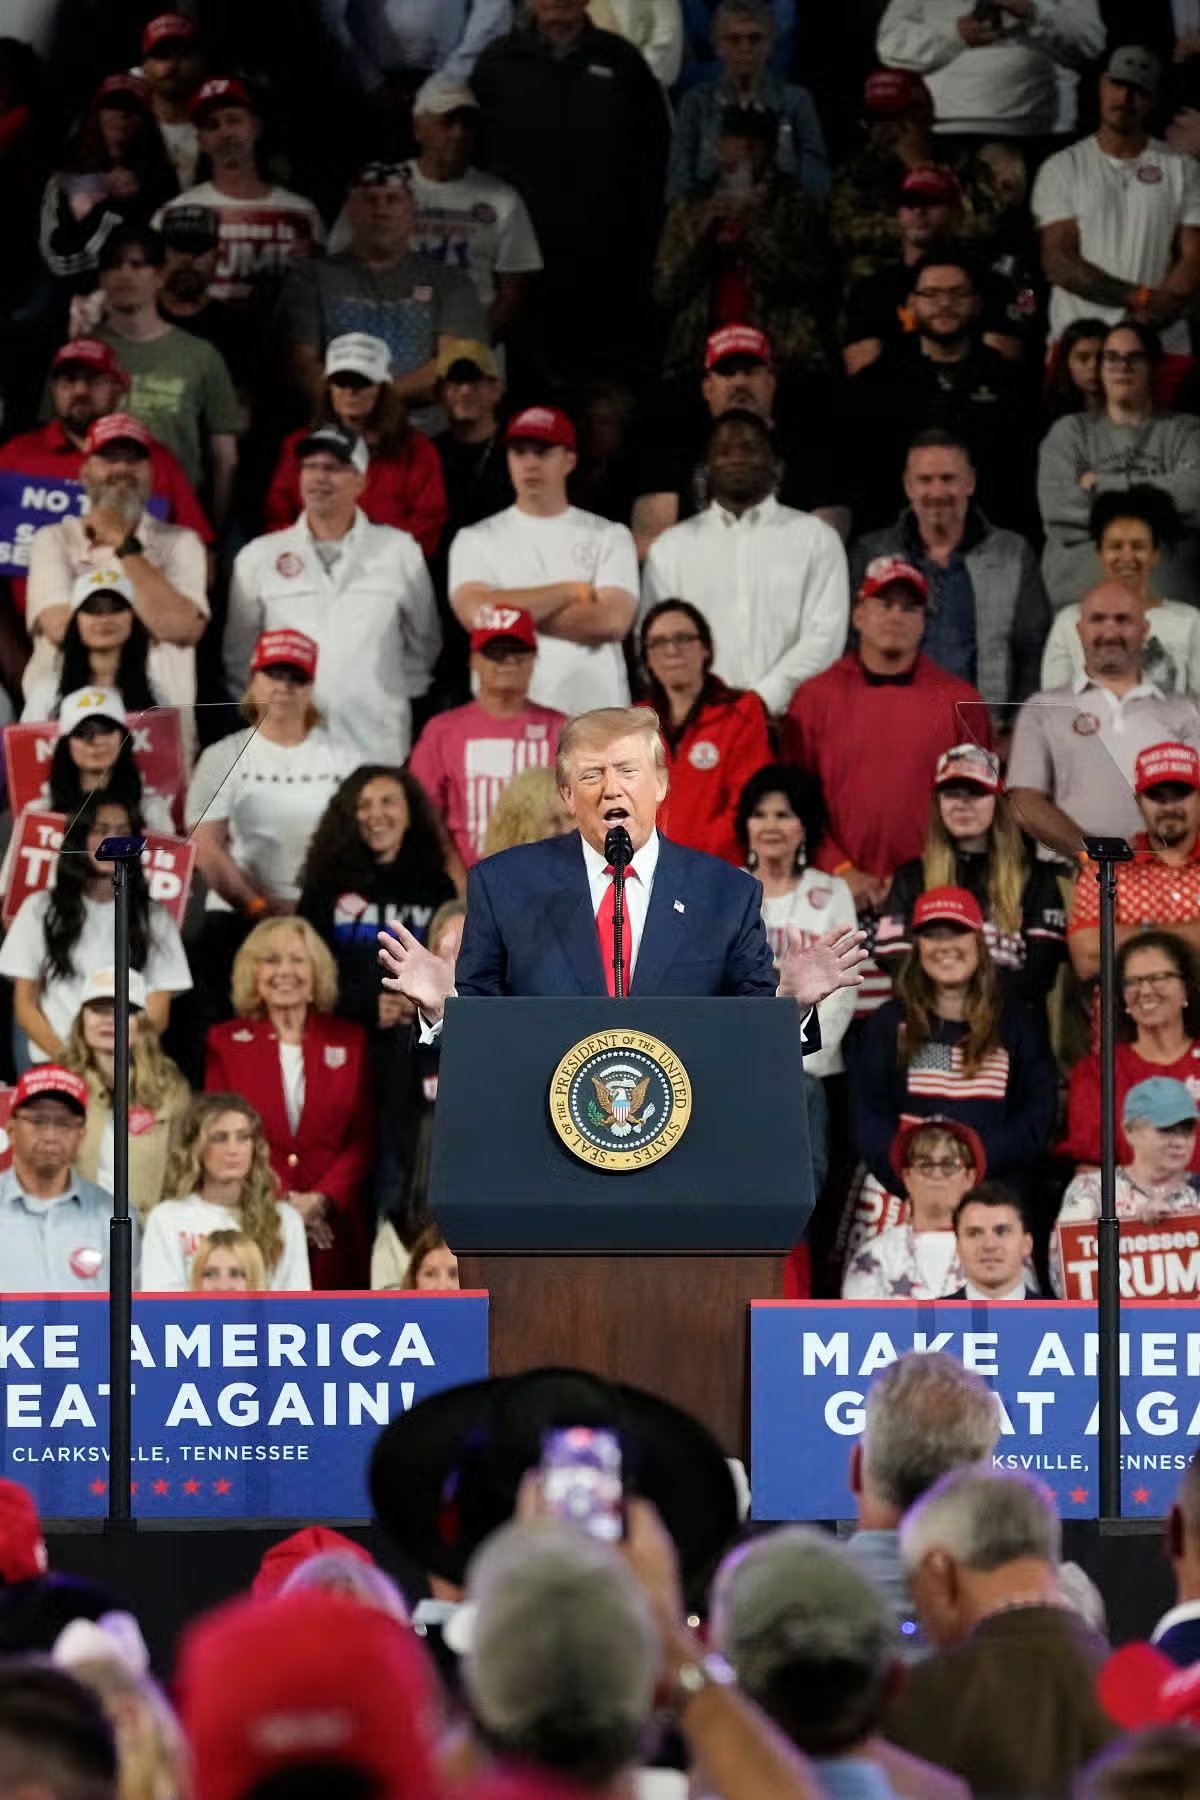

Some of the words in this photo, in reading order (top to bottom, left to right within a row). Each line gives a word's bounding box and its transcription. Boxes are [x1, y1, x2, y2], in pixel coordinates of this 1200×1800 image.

[21, 486, 70, 513] NO
[622, 1036, 636, 1046] OF
[638, 1039, 656, 1053] THE
[556, 1035, 618, 1096] PRESIDENT
[659, 1052, 687, 1109] UNITED
[556, 1100, 567, 1121] THE
[562, 1123, 573, 1136] OF
[633, 1122, 681, 1163] STATES
[571, 1133, 607, 1163] SEAL
[1077, 1231, 1199, 1257] Tnessee
[0, 1324, 80, 1369] KE
[130, 1322, 436, 1368] AMERICA
[179, 1445, 309, 1461] TENNESSEE
